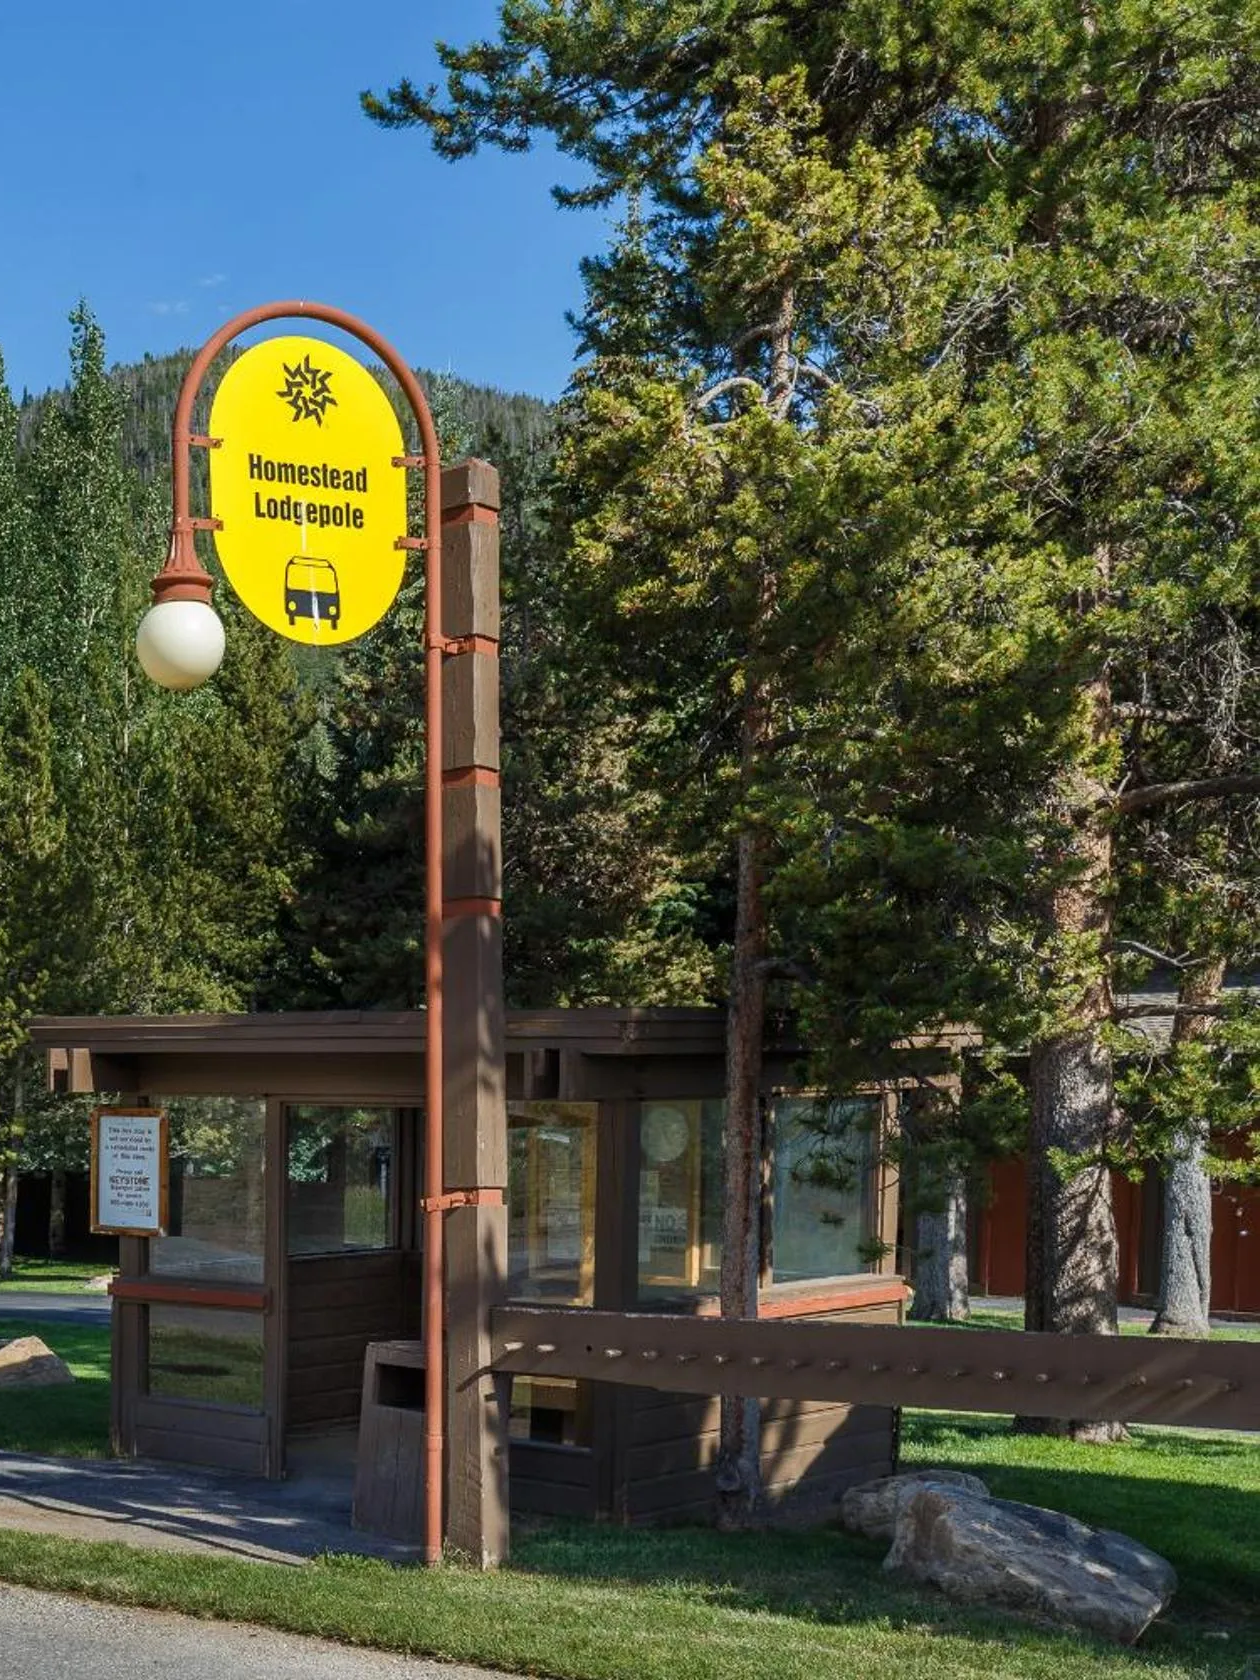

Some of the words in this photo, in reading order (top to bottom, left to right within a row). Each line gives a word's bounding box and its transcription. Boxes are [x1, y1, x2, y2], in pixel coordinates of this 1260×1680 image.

[248, 453, 367, 493] Homestead
[255, 492, 364, 529] Lodgepole
[109, 1175, 150, 1185] KEYSTONE
